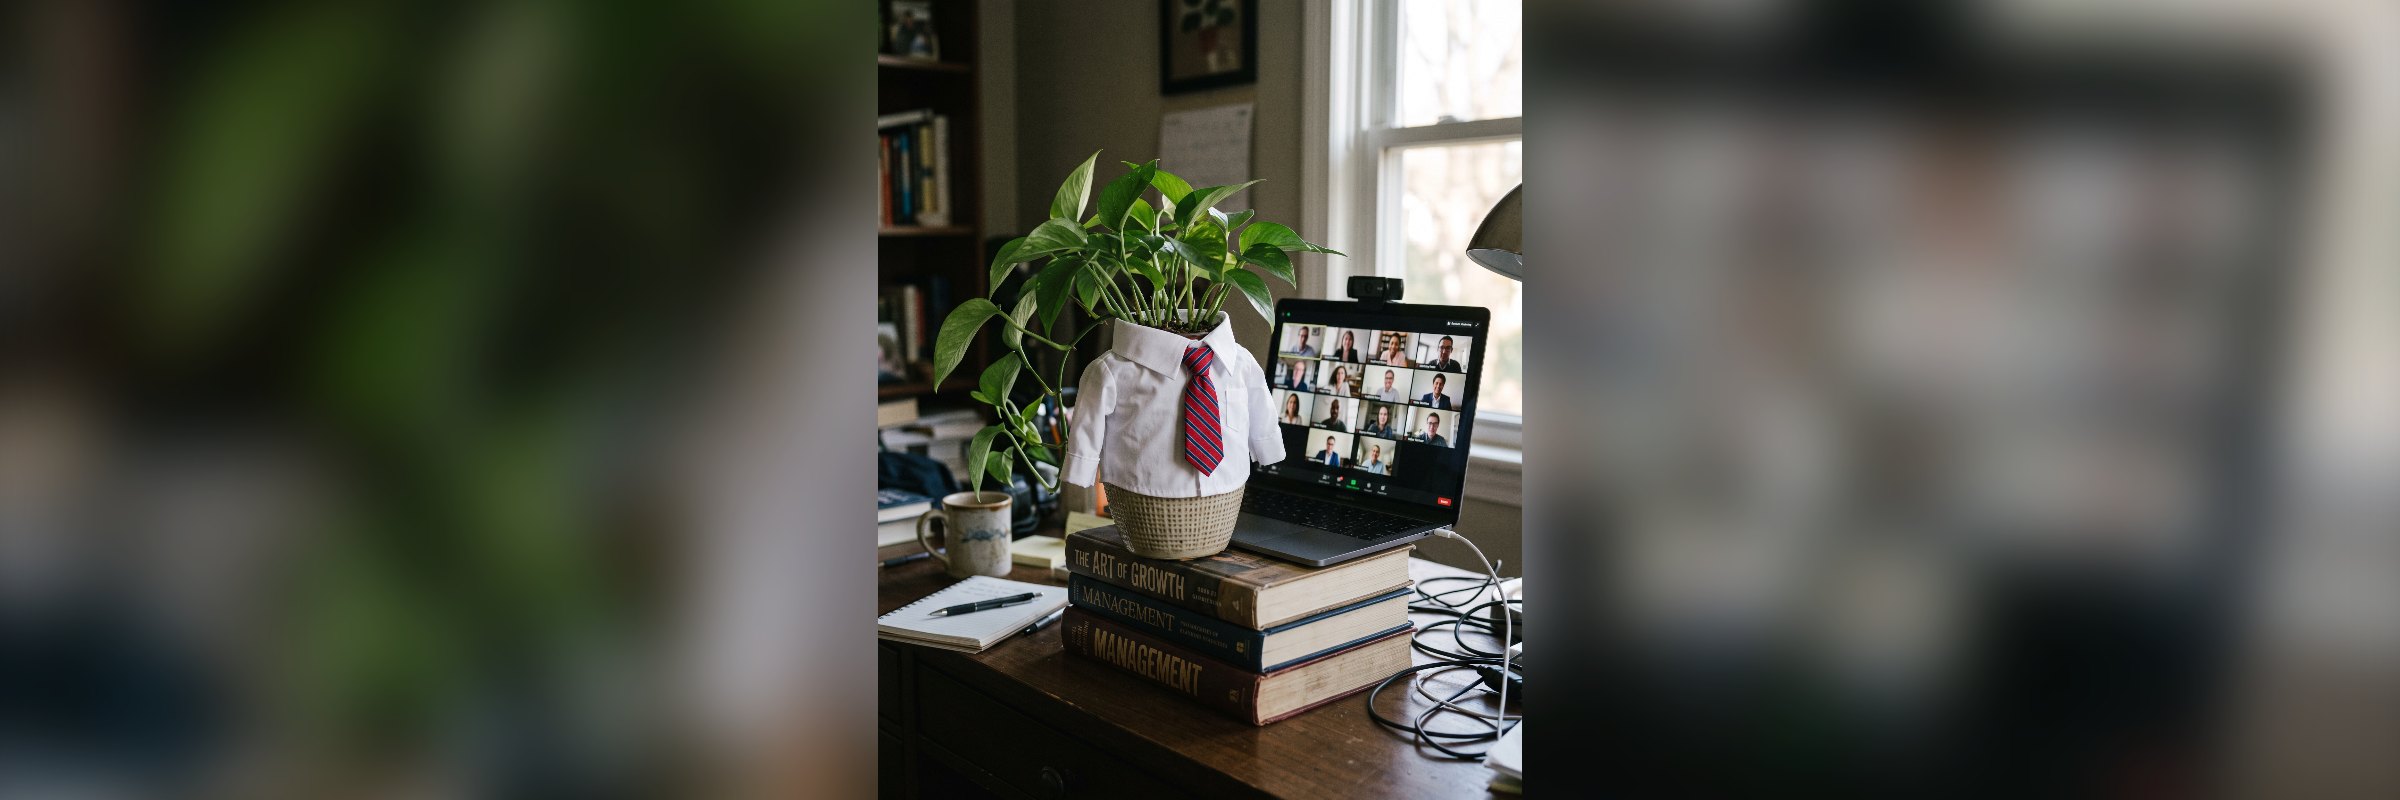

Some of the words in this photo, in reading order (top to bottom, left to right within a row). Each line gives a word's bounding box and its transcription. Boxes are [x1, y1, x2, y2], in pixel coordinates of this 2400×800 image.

[1074, 549, 1090, 568] THE
[1092, 550, 1115, 579] ART
[1117, 562, 1128, 580] OF
[1131, 561, 1185, 600] GROWTH
[1083, 585, 1175, 631] MANAGEMENT
[1094, 627, 1203, 697] MANAGEMENT
